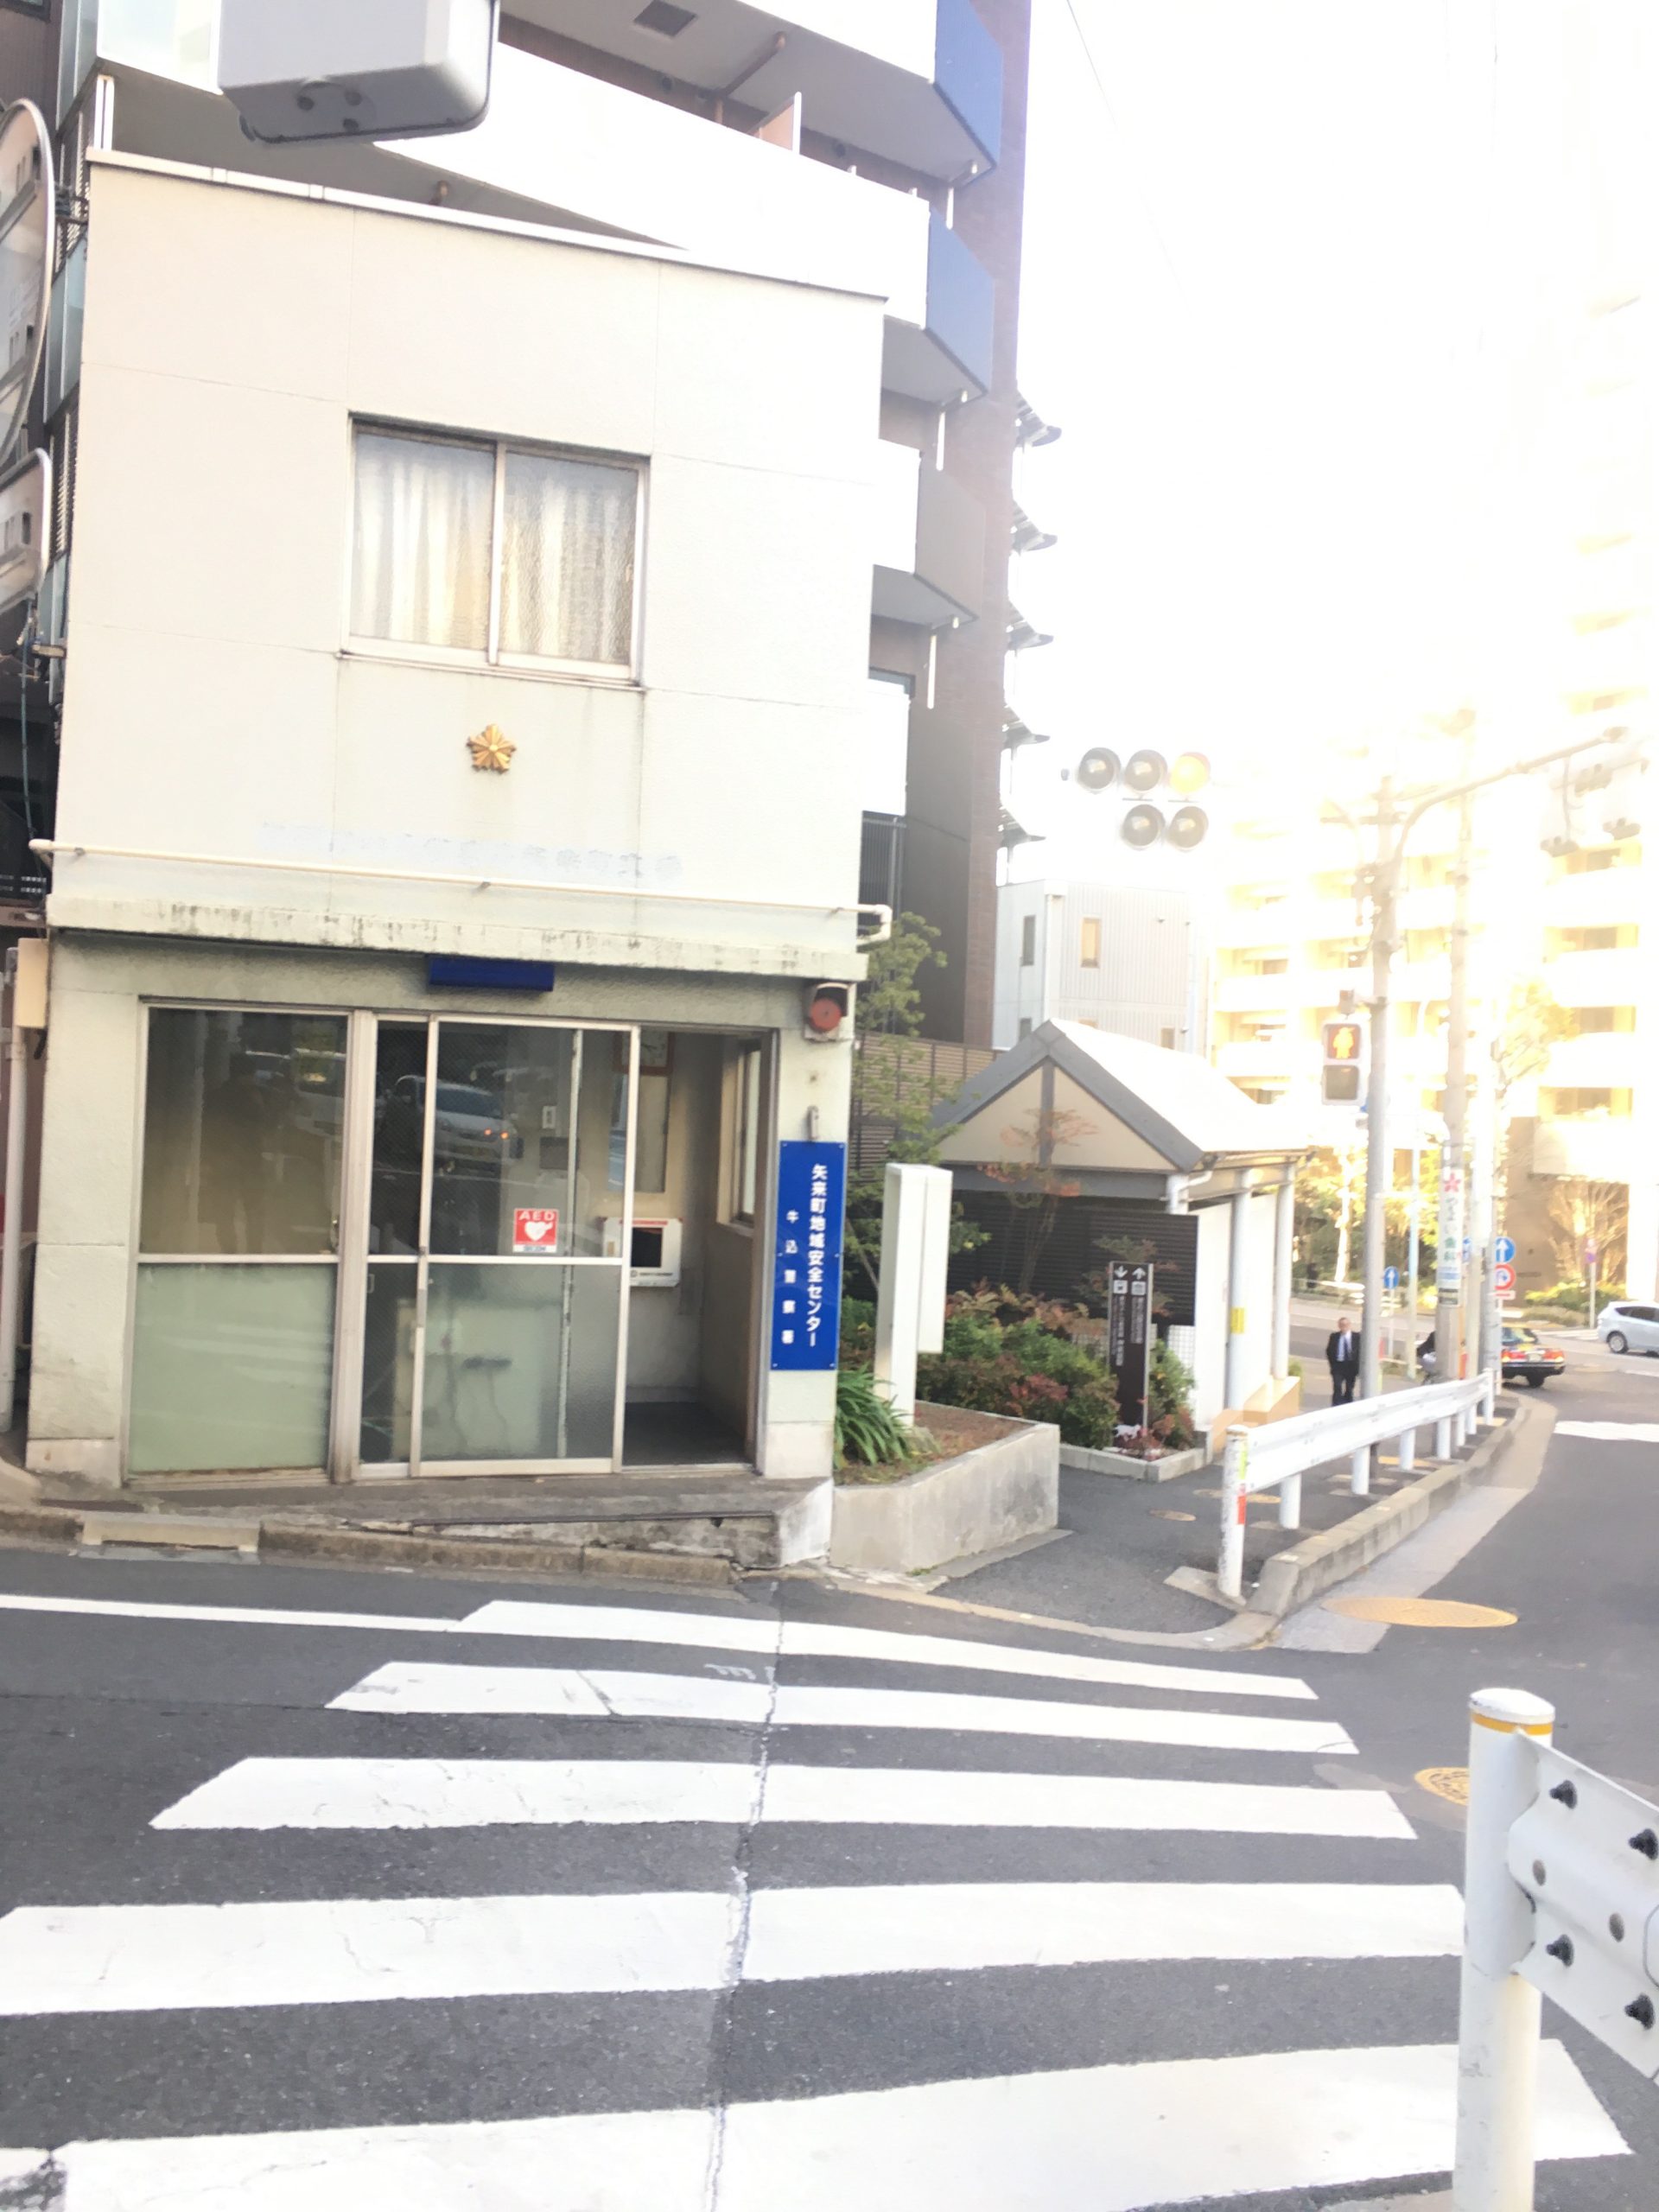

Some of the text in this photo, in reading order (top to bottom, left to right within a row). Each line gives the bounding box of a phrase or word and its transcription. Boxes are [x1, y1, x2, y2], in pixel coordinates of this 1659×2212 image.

[518, 1210, 556, 1221] AED
[806, 1163, 828, 1347] 矢来町地域安全センター
